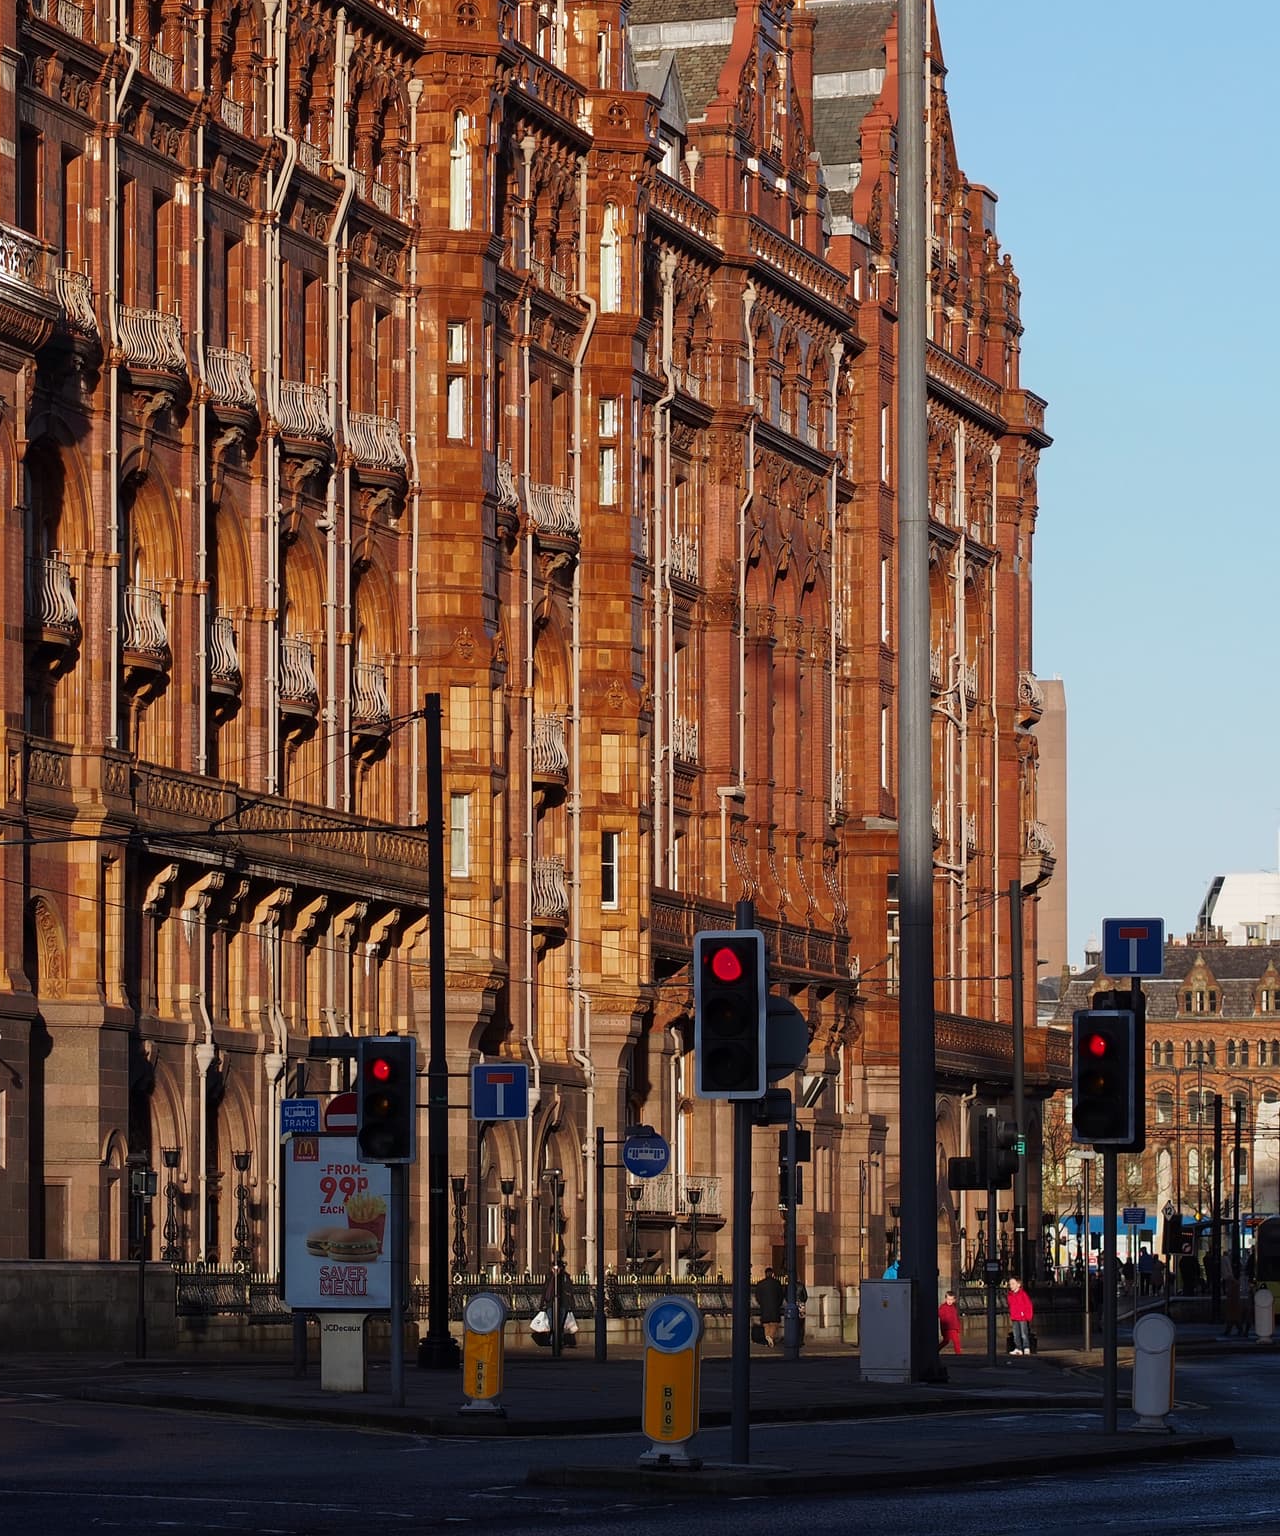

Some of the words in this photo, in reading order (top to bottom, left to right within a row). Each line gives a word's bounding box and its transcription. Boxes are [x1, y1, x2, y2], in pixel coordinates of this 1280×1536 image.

[284, 1119, 316, 1127] TRAMS
[320, 1206, 345, 1214] EACH
[320, 1266, 368, 1280] SAVER
[320, 1280, 368, 1296] MENU
[323, 1324, 361, 1332] JCDecaux
